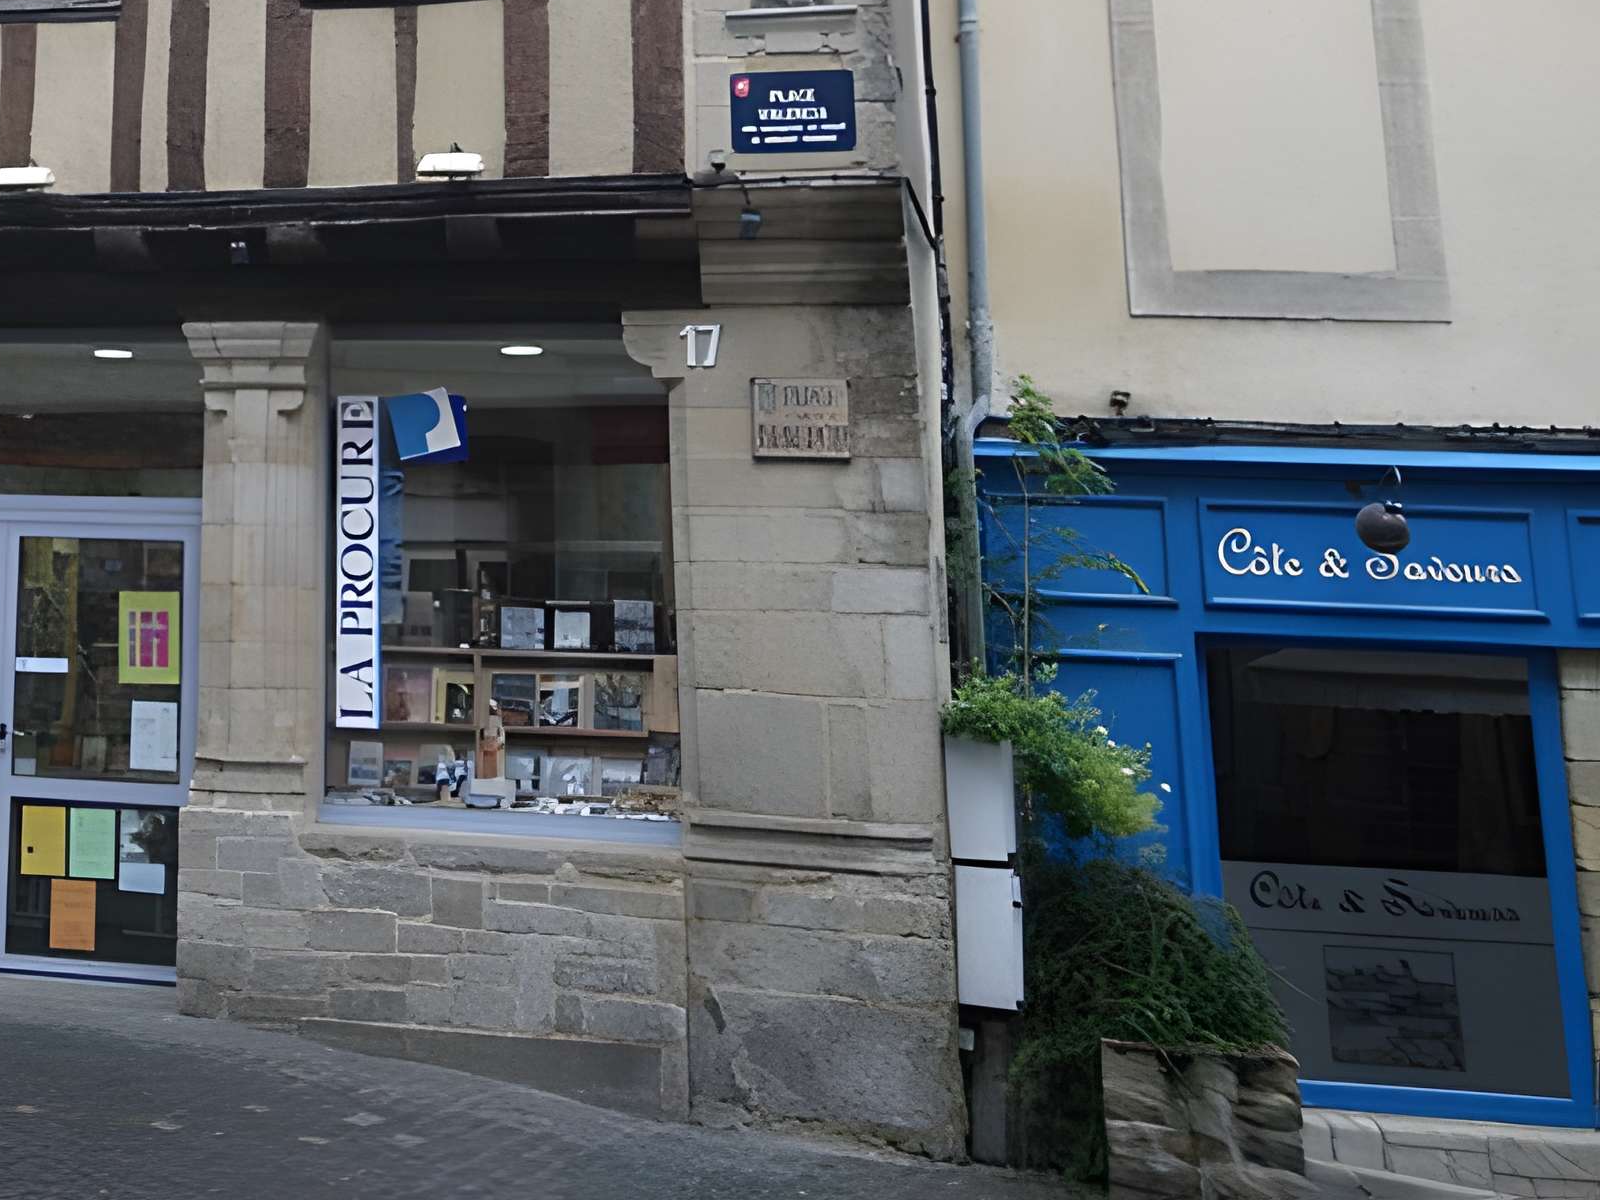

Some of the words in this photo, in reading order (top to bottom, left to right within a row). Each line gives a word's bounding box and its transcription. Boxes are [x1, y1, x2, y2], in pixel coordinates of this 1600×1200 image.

[679, 323, 721, 368] 17
[1318, 548, 1350, 579] &
[339, 657, 374, 719] LA
